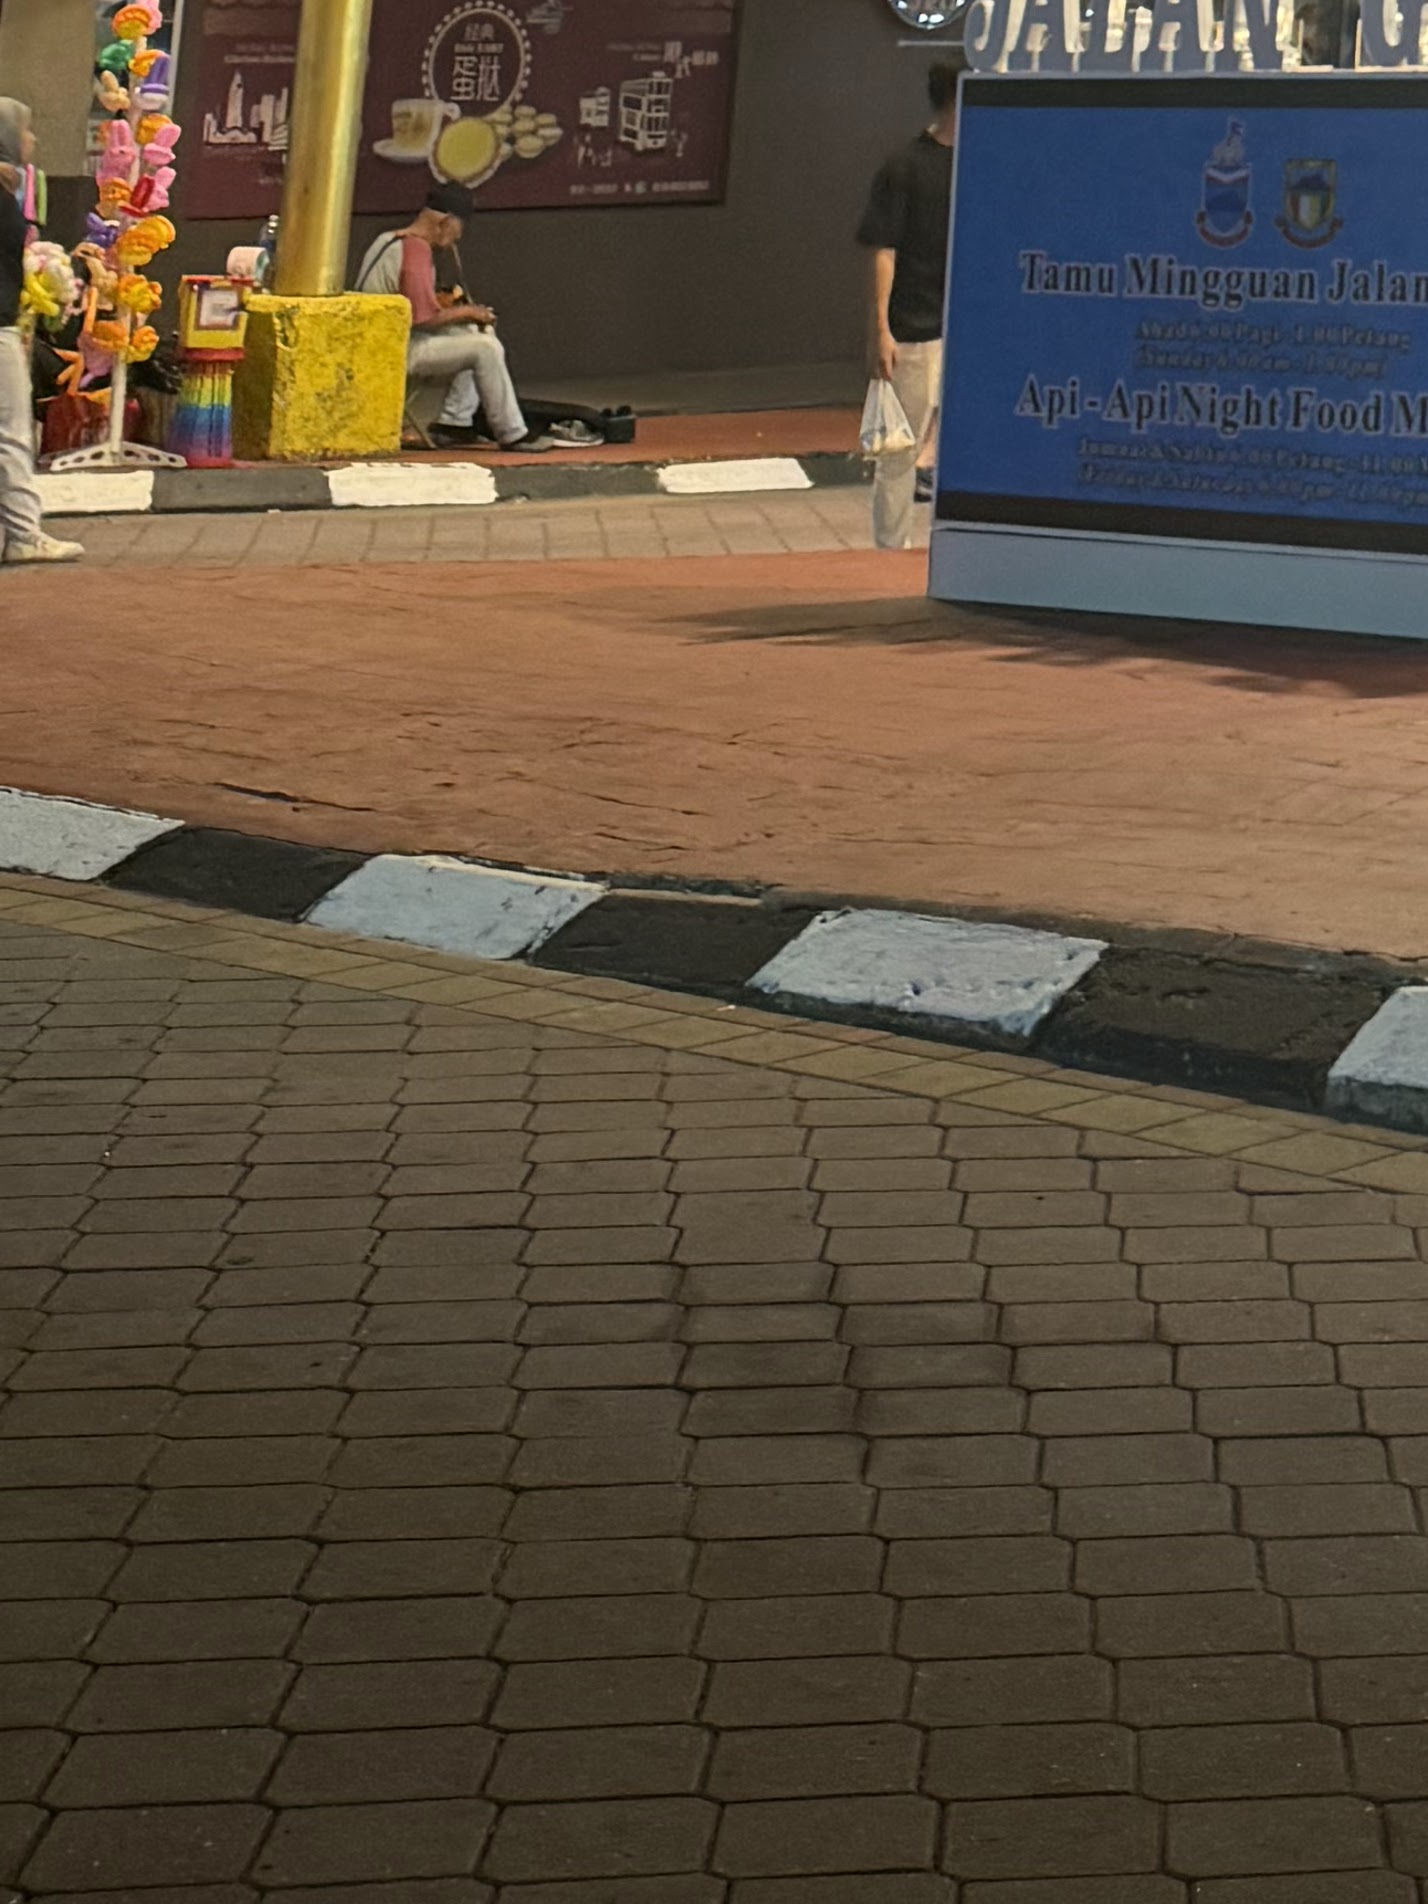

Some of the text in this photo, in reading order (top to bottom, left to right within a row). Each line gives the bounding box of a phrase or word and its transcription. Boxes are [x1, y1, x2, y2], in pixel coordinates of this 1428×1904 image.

[1020, 252, 1115, 295] Tamu
[1126, 256, 1316, 308] Mingguan
[1016, 375, 1079, 427] Api
[1106, 380, 1168, 430] Api
[1179, 385, 1282, 435] Night
[1289, 389, 1383, 434] Food
